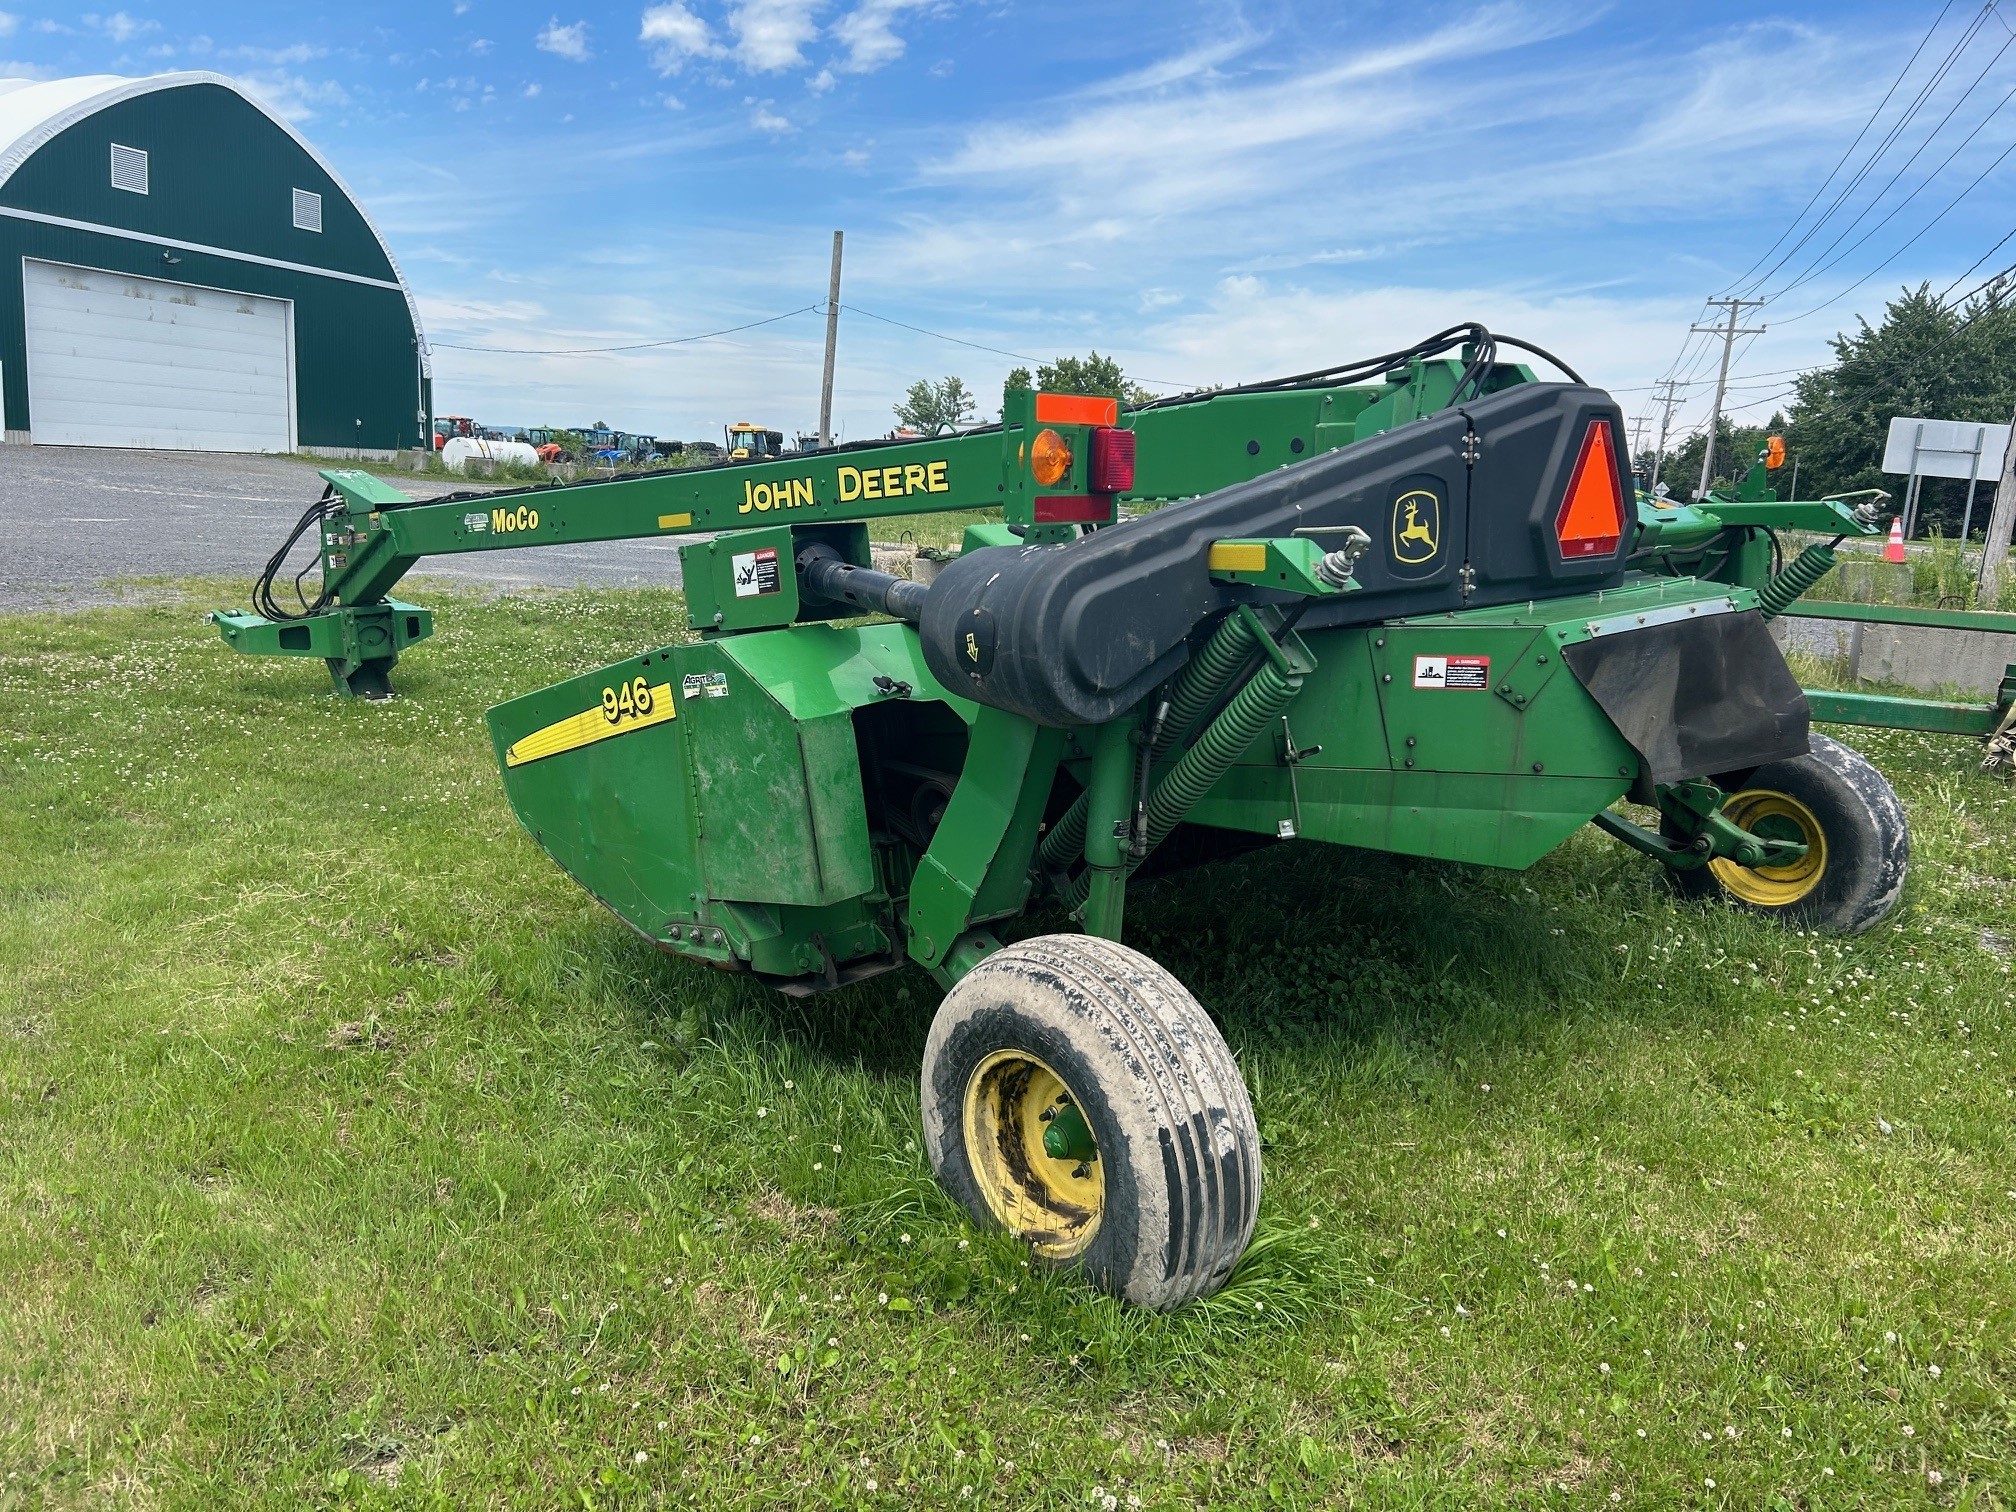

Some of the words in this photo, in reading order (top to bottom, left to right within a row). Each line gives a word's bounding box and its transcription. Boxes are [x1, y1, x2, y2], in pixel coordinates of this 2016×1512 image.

[737, 477, 815, 514] JOHN
[837, 460, 949, 503] DEERE
[492, 505, 540, 533] MoCo
[602, 676, 653, 723] 946
